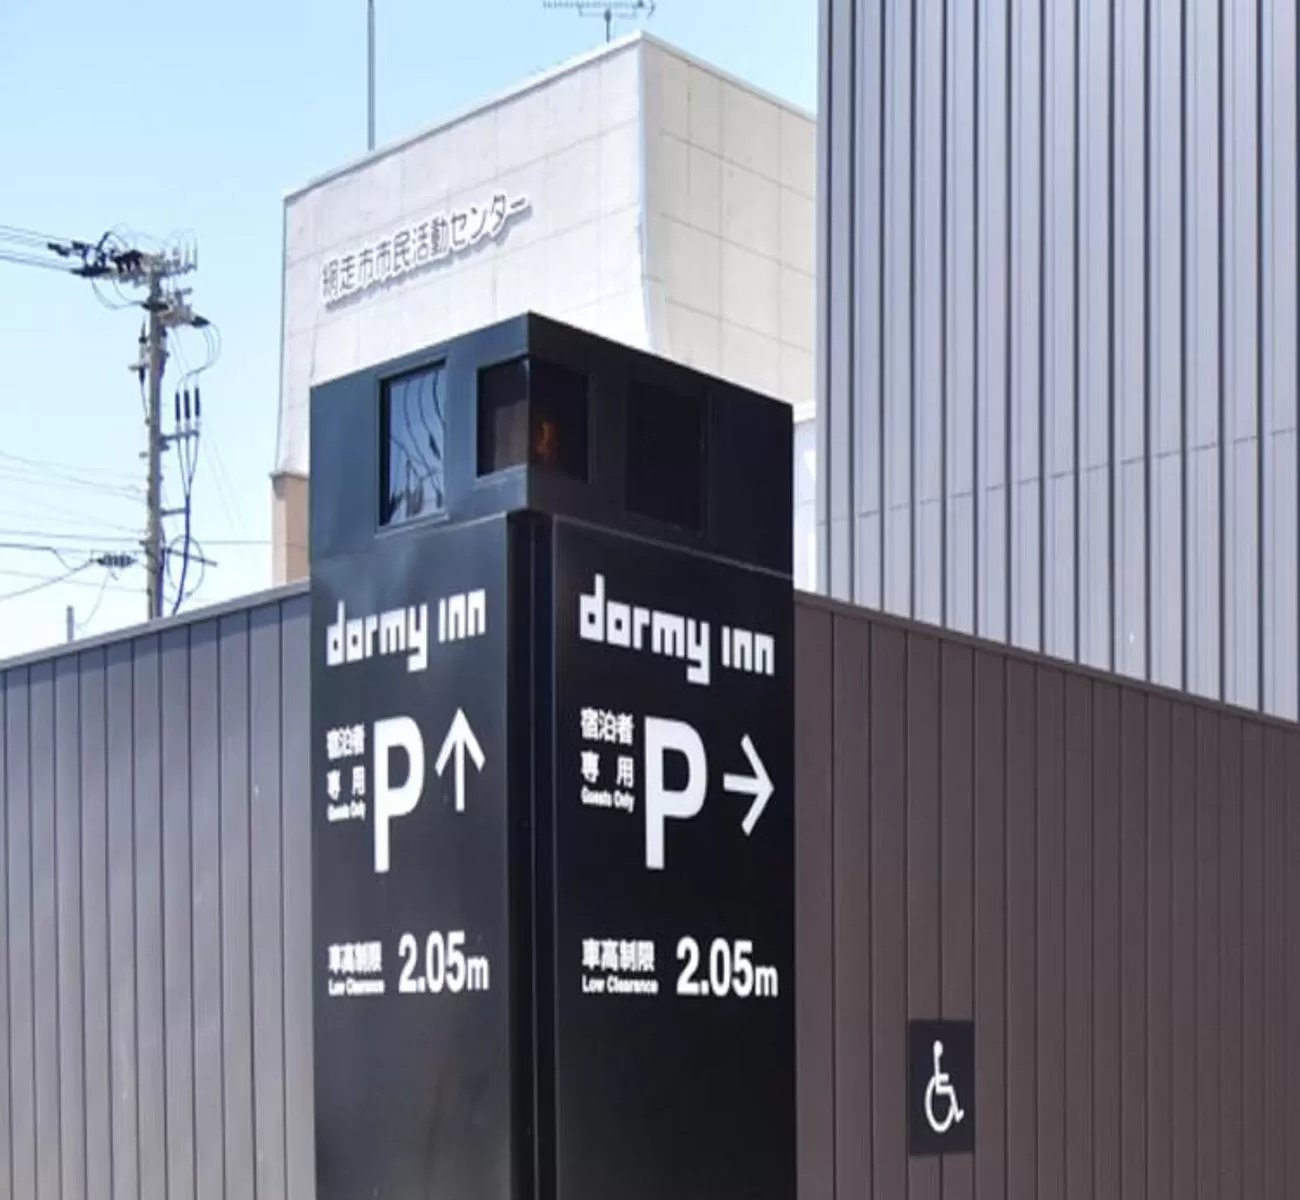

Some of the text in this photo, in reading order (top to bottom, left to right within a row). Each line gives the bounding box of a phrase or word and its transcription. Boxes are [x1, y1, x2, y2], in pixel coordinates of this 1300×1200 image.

[321, 193, 527, 301] 網走市市民活動センター
[326, 588, 486, 673] dormy inn
[579, 574, 774, 685] dormy inn
[374, 715, 425, 873] P
[644, 716, 708, 869] P
[398, 930, 489, 994] 2.05m
[676, 936, 778, 997] 2.05m
